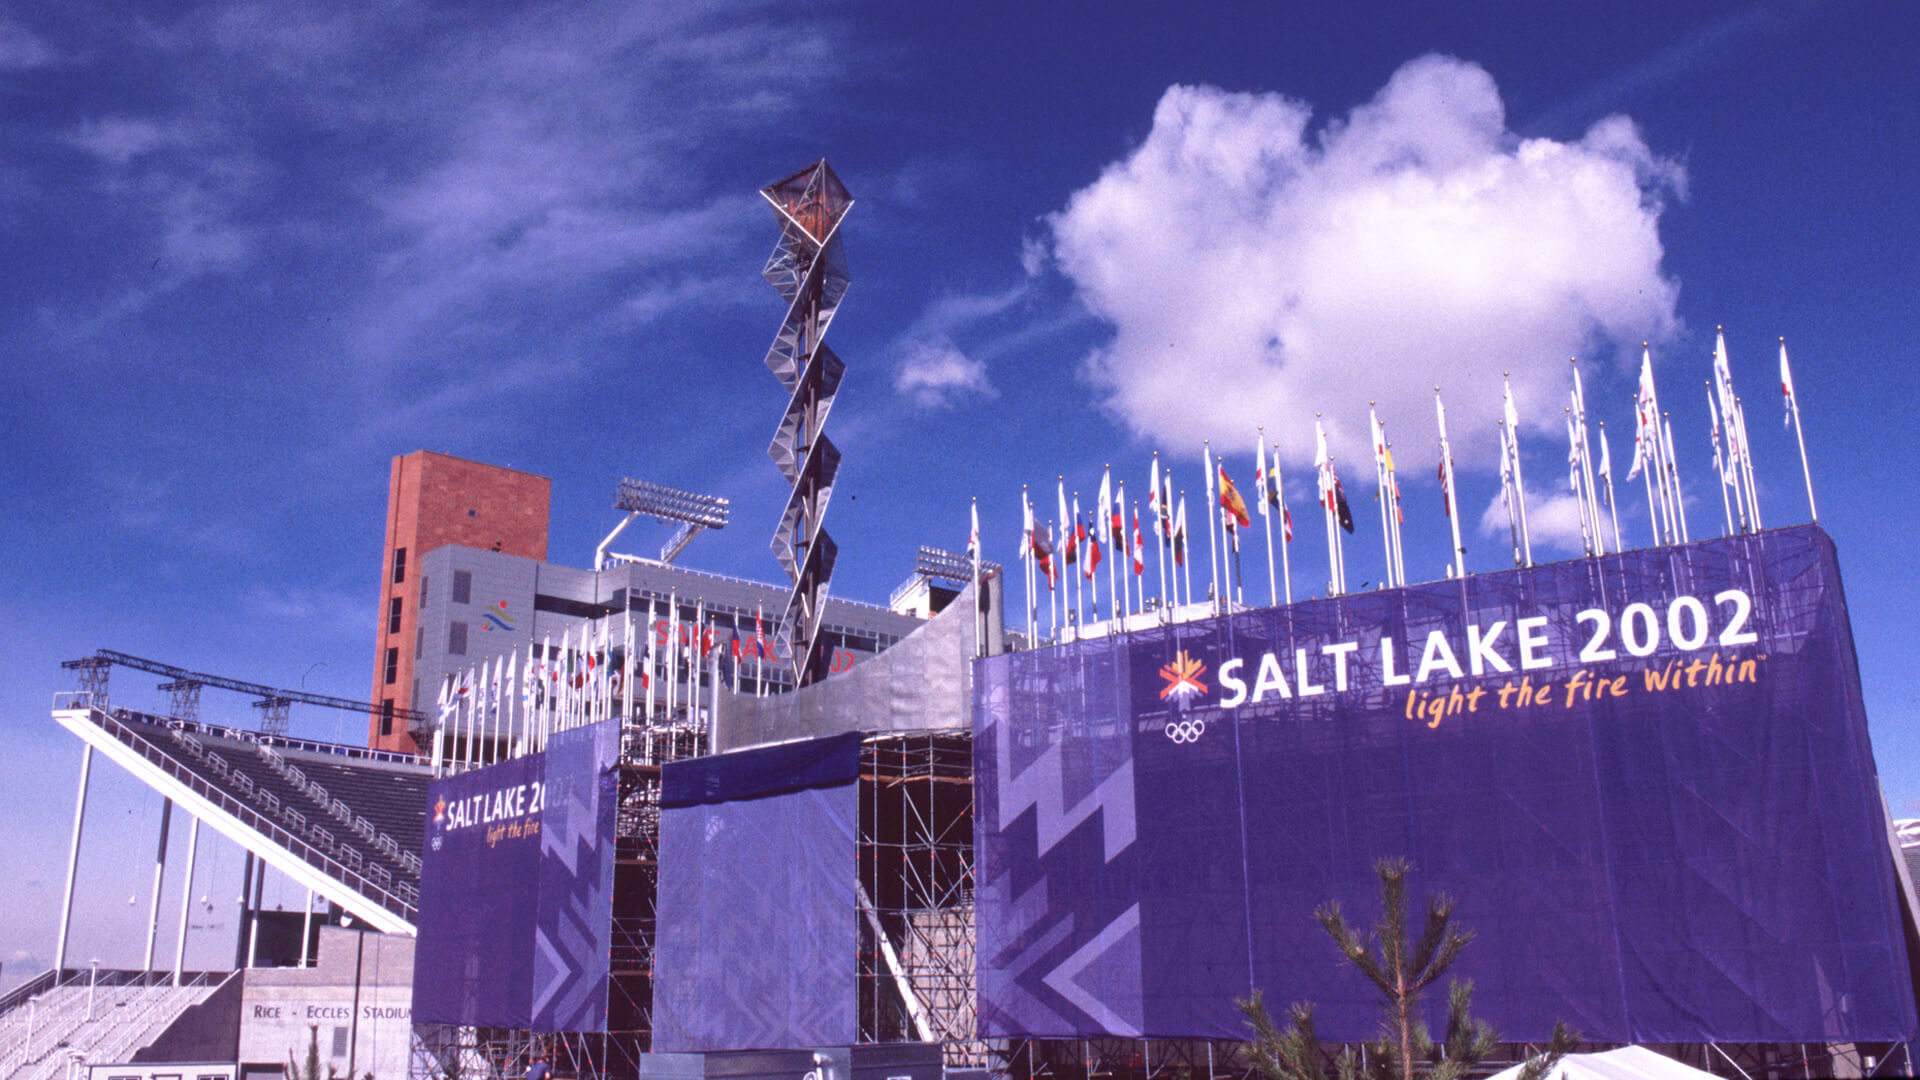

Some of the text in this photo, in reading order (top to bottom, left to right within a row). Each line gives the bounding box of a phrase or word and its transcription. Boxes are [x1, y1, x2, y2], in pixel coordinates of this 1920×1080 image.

[1218, 589, 1759, 708] SALT LAKE 2002
[1405, 684, 1487, 728] light
[1498, 676, 1552, 709] the
[1564, 669, 1629, 708] fire
[446, 794, 483, 831] SALT
[483, 784, 527, 823] LAKE
[486, 817, 540, 848] light the fire
[253, 1004, 281, 1019] RICE
[306, 1005, 350, 1019] ECCLES
